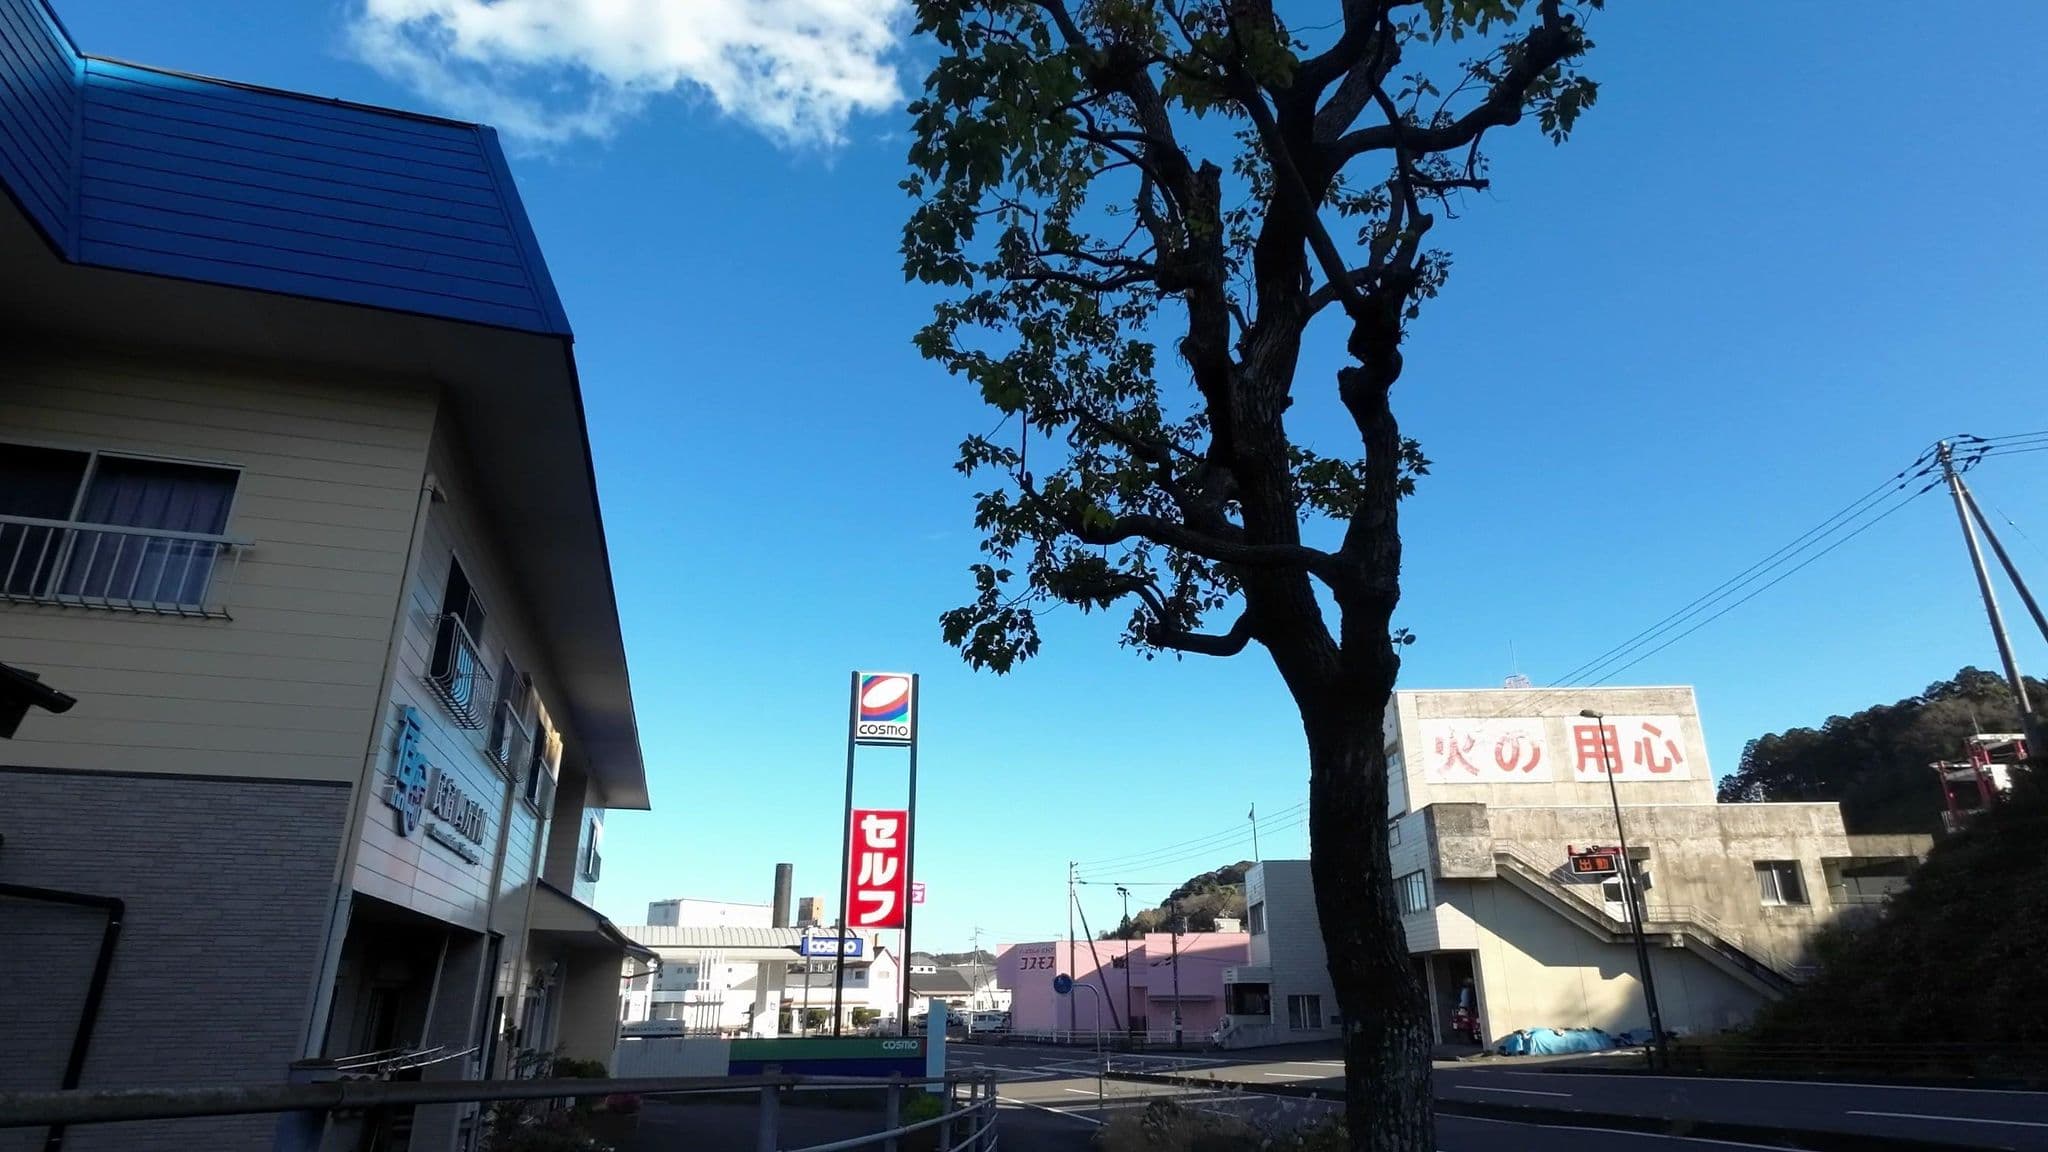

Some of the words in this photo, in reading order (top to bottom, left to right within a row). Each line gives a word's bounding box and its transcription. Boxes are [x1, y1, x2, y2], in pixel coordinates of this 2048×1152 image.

[859, 724, 908, 736] COSMO
[1435, 722, 1683, 776] 火の用心
[857, 814, 898, 925] セルフ
[1020, 956, 1055, 970] コスモス
[882, 1040, 918, 1050] COSMO
